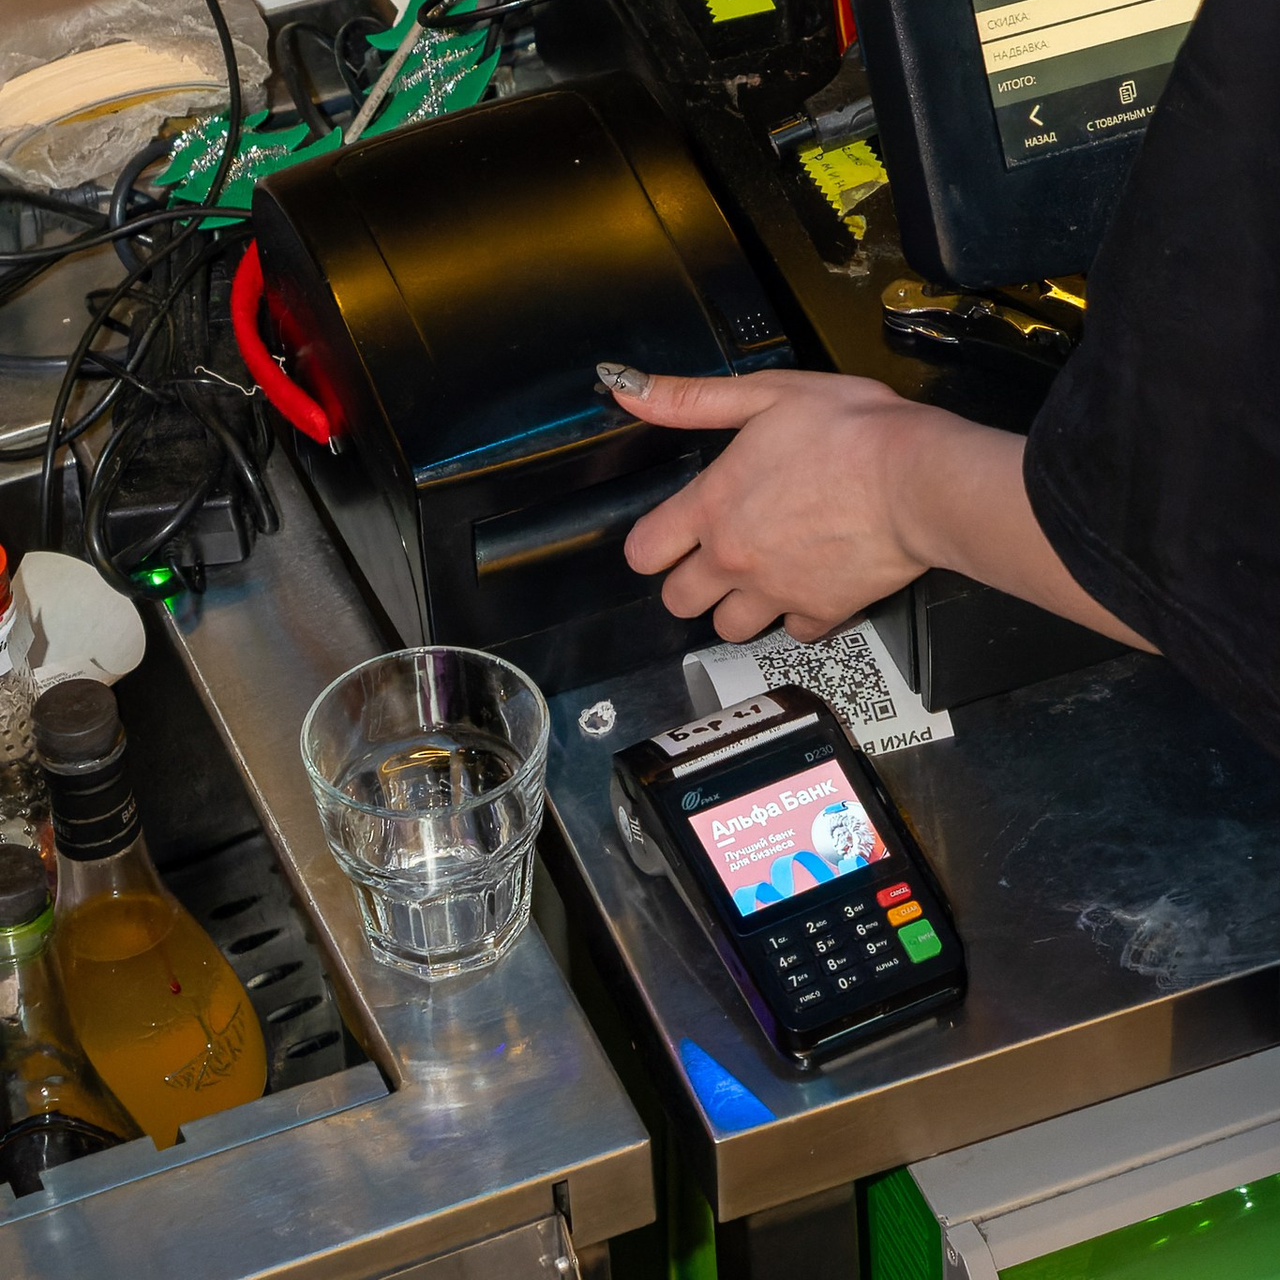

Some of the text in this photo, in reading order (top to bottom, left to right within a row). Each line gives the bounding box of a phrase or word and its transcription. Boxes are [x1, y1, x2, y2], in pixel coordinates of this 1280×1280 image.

[997, 75, 1037, 94] ИТОГО:
[1024, 131, 1057, 148] НАЗАД
[1095, 108, 1146, 129] ТОВАРНЫМ
[666, 717, 724, 743] Бар
[882, 726, 933, 753] РУКИ
[805, 744, 833, 763] D230
[711, 779, 838, 841] Альфа Банк
[724, 828, 795, 862] Лучший банк
[729, 839, 795, 873] для бизнеса
